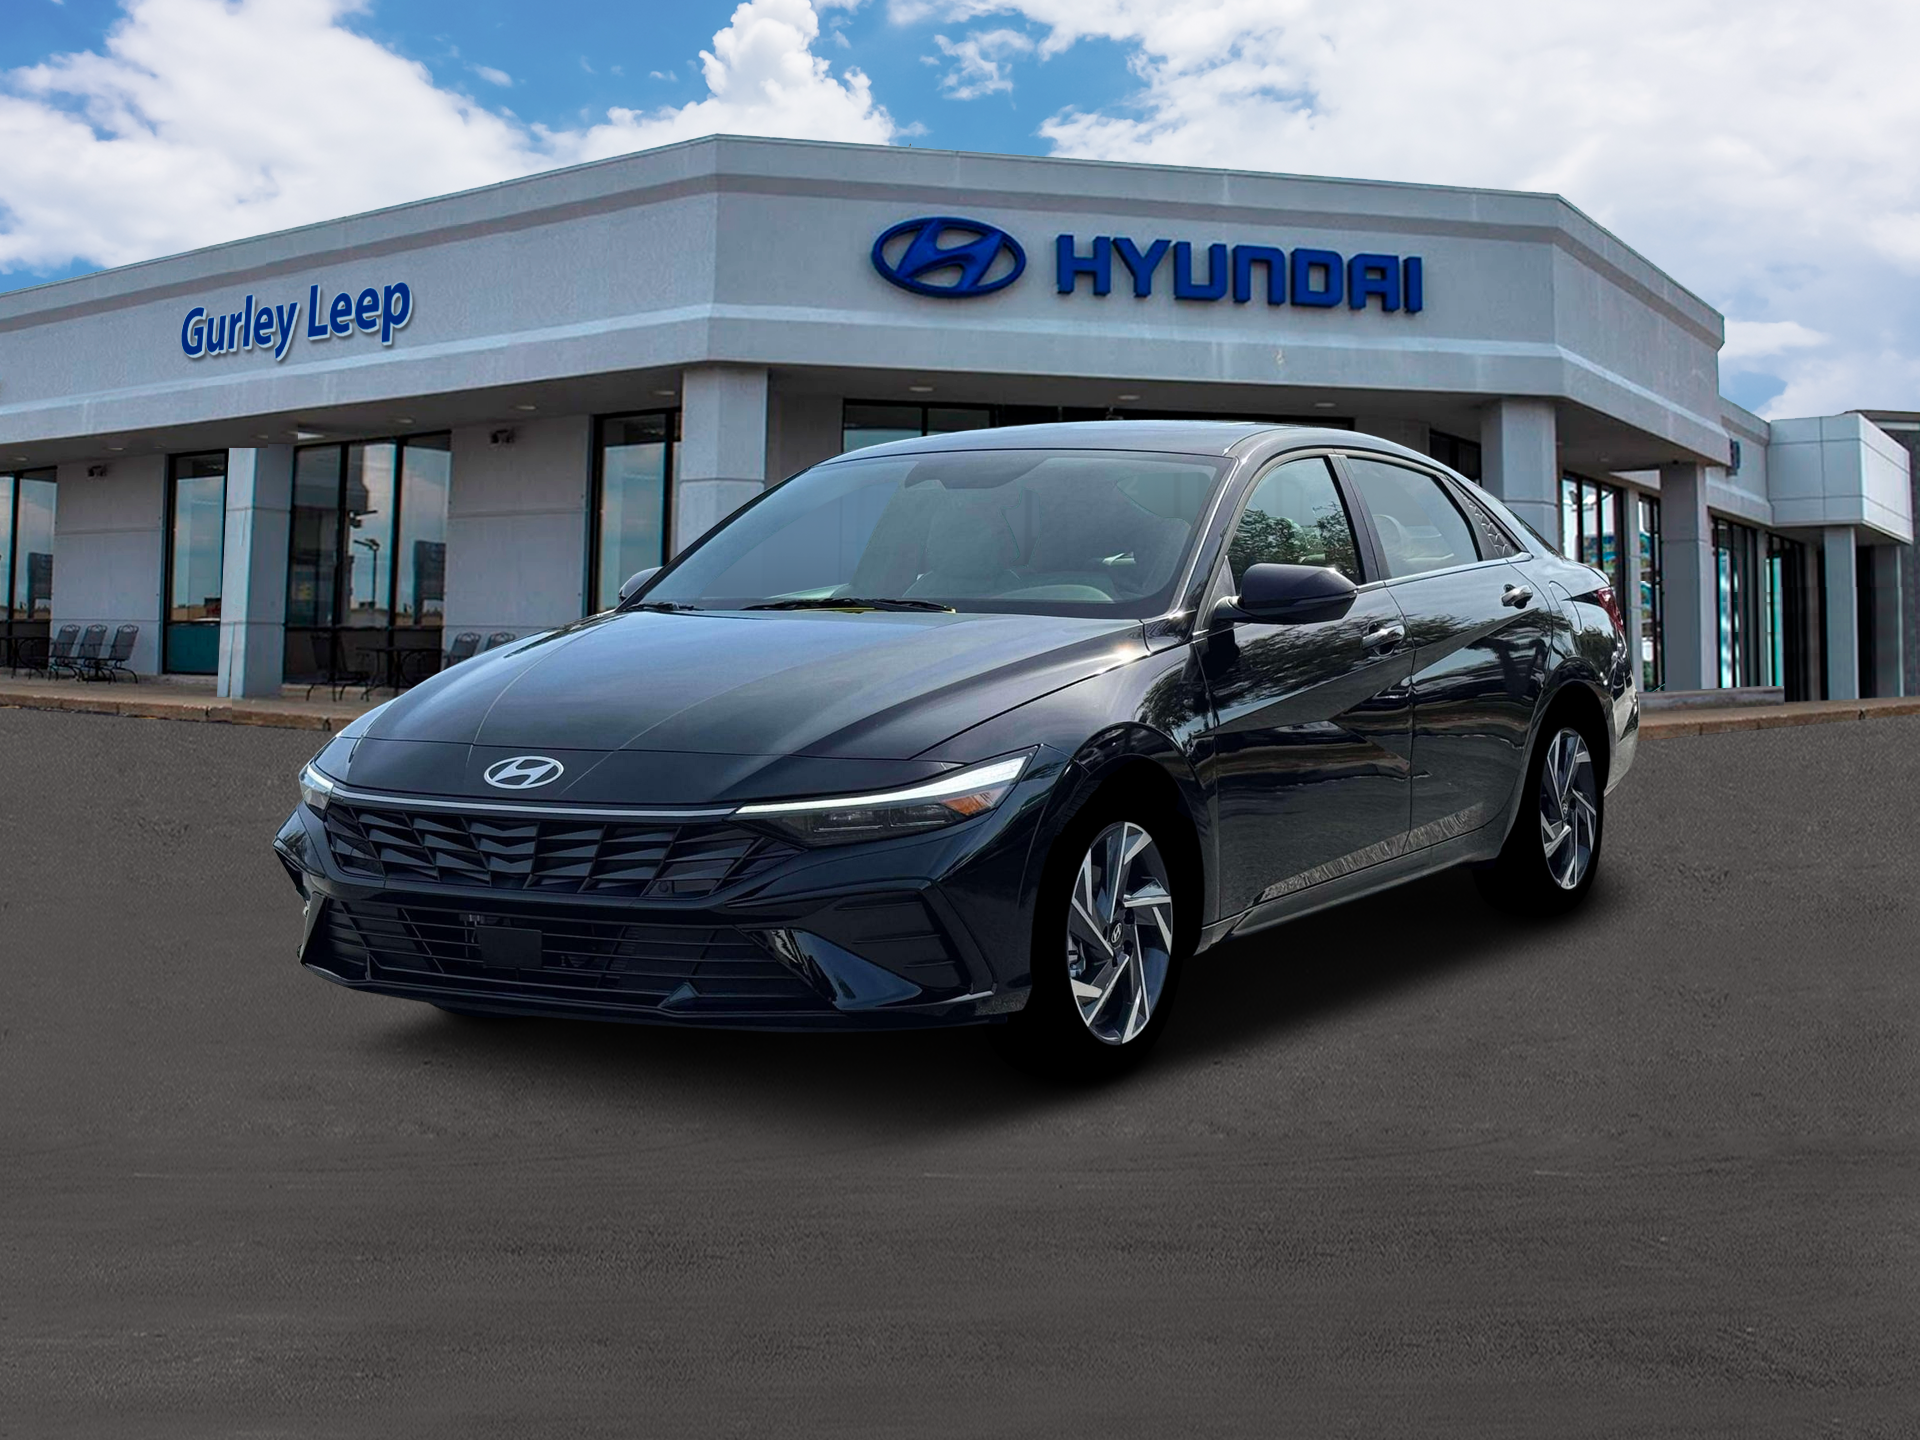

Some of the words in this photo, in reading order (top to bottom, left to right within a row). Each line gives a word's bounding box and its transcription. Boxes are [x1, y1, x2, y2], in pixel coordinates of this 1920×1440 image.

[1055, 234, 1424, 313] HYUNDAI
[181, 294, 299, 360] Gurley
[307, 282, 412, 345] Leep
